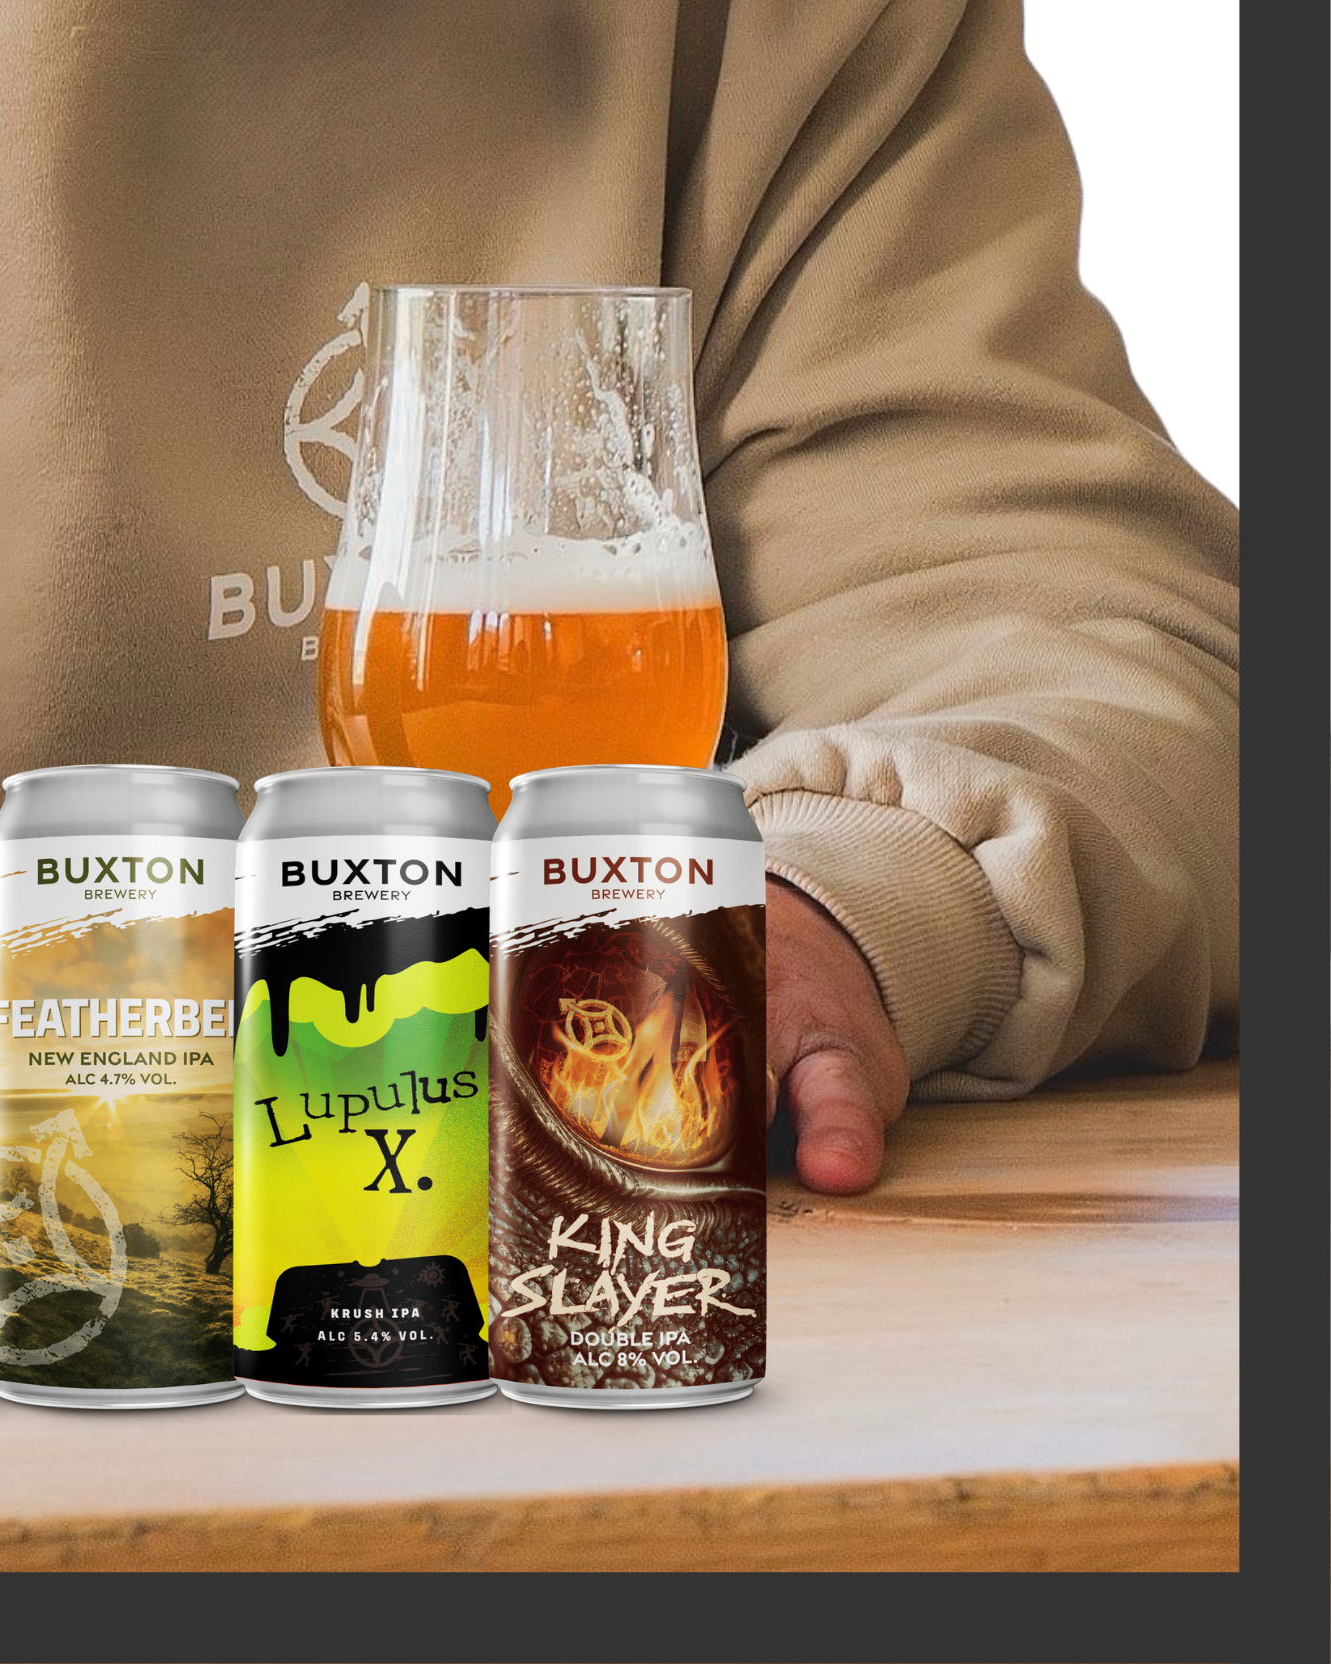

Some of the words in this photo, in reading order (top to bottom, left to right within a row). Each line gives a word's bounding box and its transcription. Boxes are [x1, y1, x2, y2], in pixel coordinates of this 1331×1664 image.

[208, 555, 336, 641] BU
[37, 857, 205, 885] BUXTON
[281, 860, 463, 887] BUXTON
[543, 857, 714, 885] BUXTON
[84, 889, 157, 900] BREWERY
[332, 890, 411, 901] BREWERY
[591, 888, 666, 900] BREWERY
[29, 1051, 75, 1066] NEW
[80, 1051, 177, 1066] ENGLAND
[183, 1051, 215, 1066] IPA
[65, 1073, 96, 1085] ALC
[100, 1073, 136, 1085] 4.7%
[140, 1073, 177, 1085] VOL.
[255, 1069, 479, 1148] Lupulus
[363, 1129, 434, 1194] X.
[547, 1210, 697, 1276] KING
[500, 1265, 757, 1334] SLAYER
[330, 1308, 384, 1319] KRUSH
[391, 1307, 420, 1319] IPA
[317, 1330, 346, 1342] ALC
[354, 1331, 392, 1342] 5.4%
[398, 1330, 434, 1341] VOL.
[570, 1332, 654, 1347] DOUBLE
[660, 1331, 691, 1345] IPA
[572, 1352, 612, 1367] ALC
[617, 1353, 646, 1367] 8%
[651, 1350, 698, 1366] VOL.
